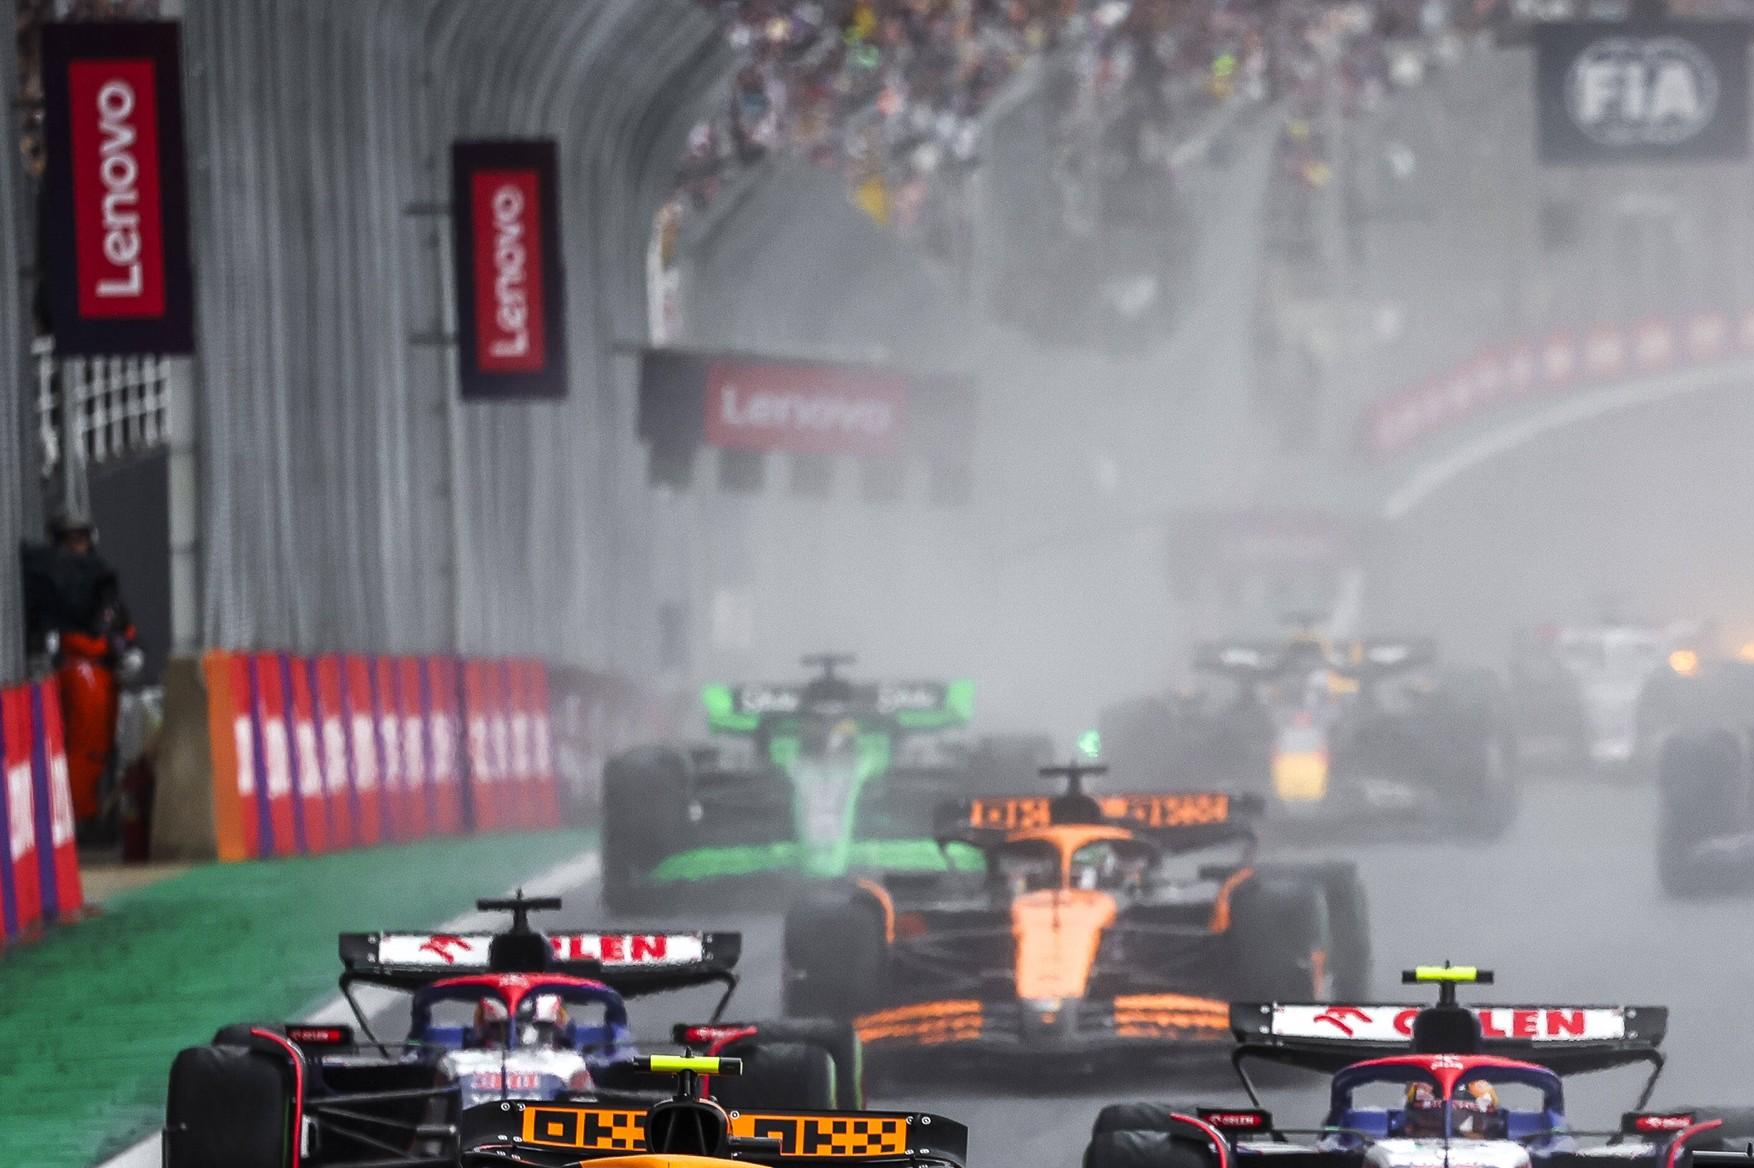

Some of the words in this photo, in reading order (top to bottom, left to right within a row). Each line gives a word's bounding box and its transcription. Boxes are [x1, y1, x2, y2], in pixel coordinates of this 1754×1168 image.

[1577, 59, 1699, 121] FIA
[96, 79, 144, 297] Lenovo
[490, 184, 530, 357] Lenovo
[551, 934, 668, 963] LEN
[1393, 1008, 1585, 1039] OLEN
